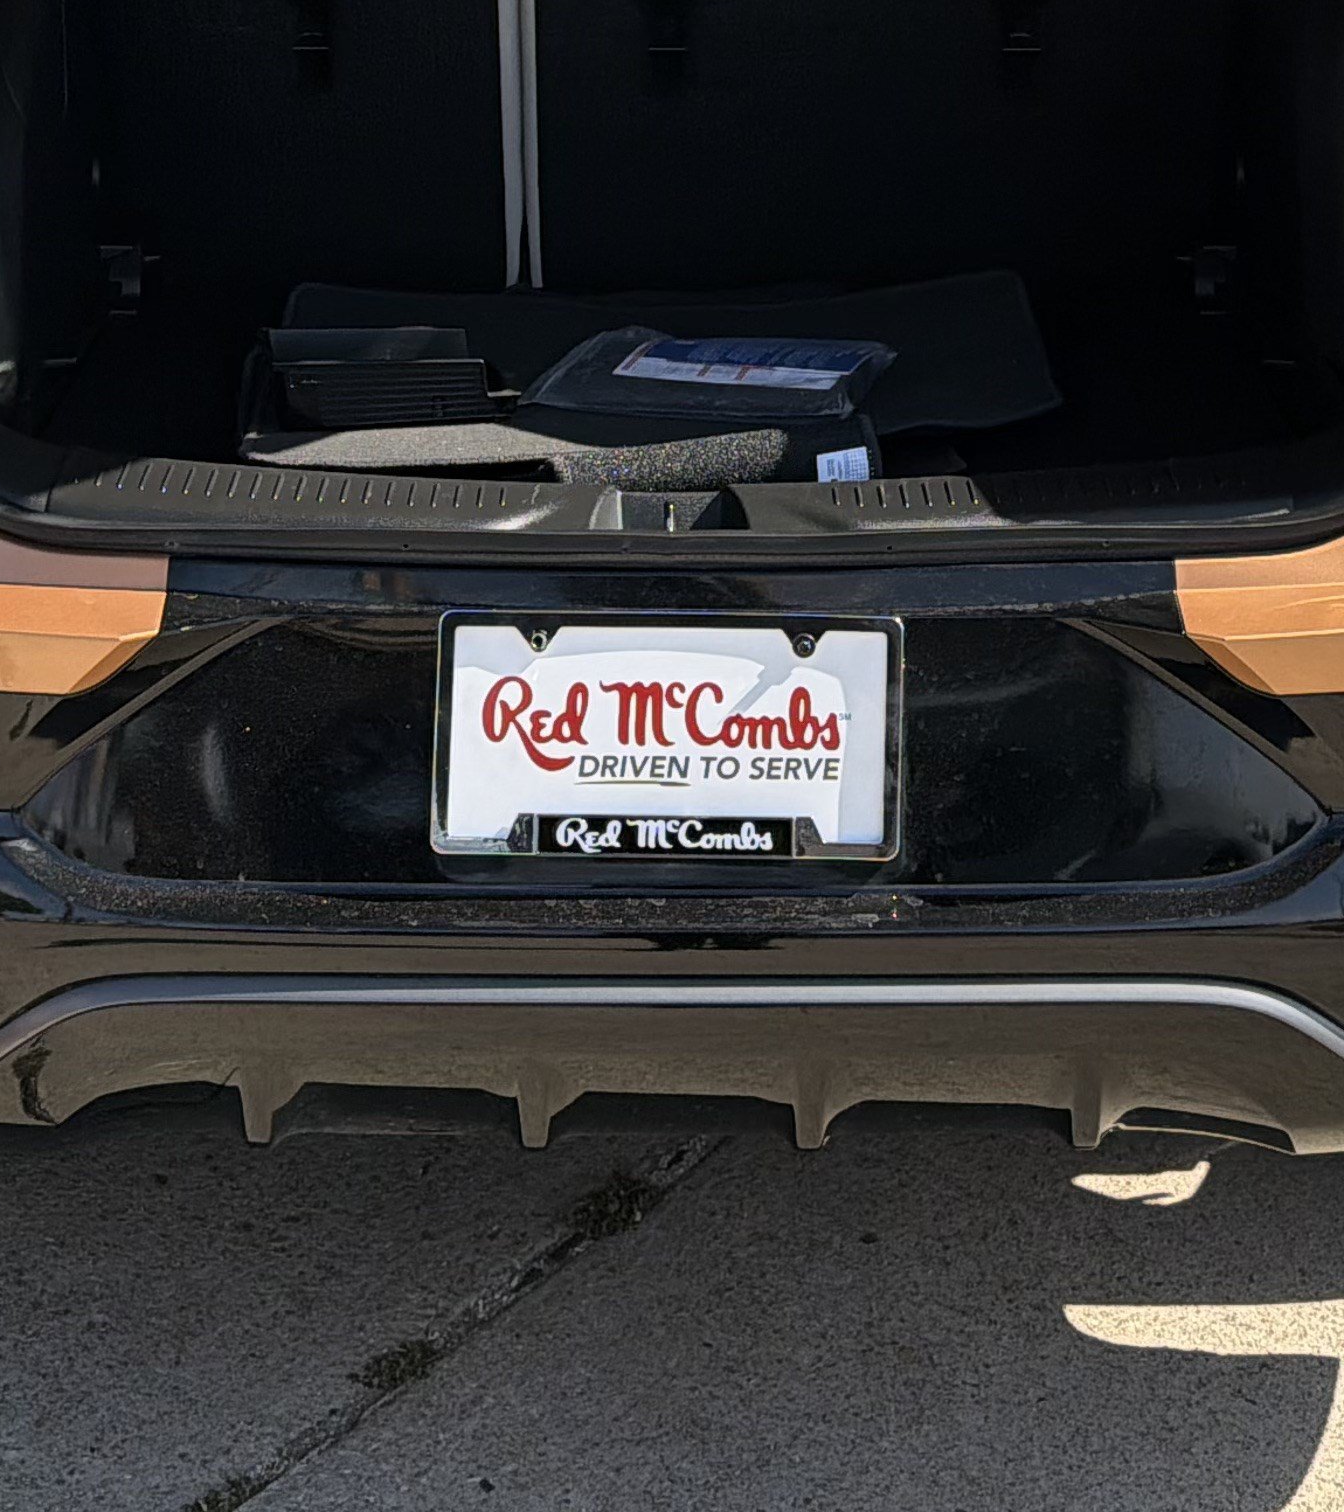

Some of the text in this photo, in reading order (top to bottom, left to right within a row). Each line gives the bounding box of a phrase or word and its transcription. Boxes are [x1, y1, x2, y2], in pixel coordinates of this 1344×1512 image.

[482, 676, 590, 772] Red
[599, 680, 841, 752] McCombs
[577, 754, 841, 781] DRIVEN TO SERVE
[556, 817, 774, 855] Red McCombs
